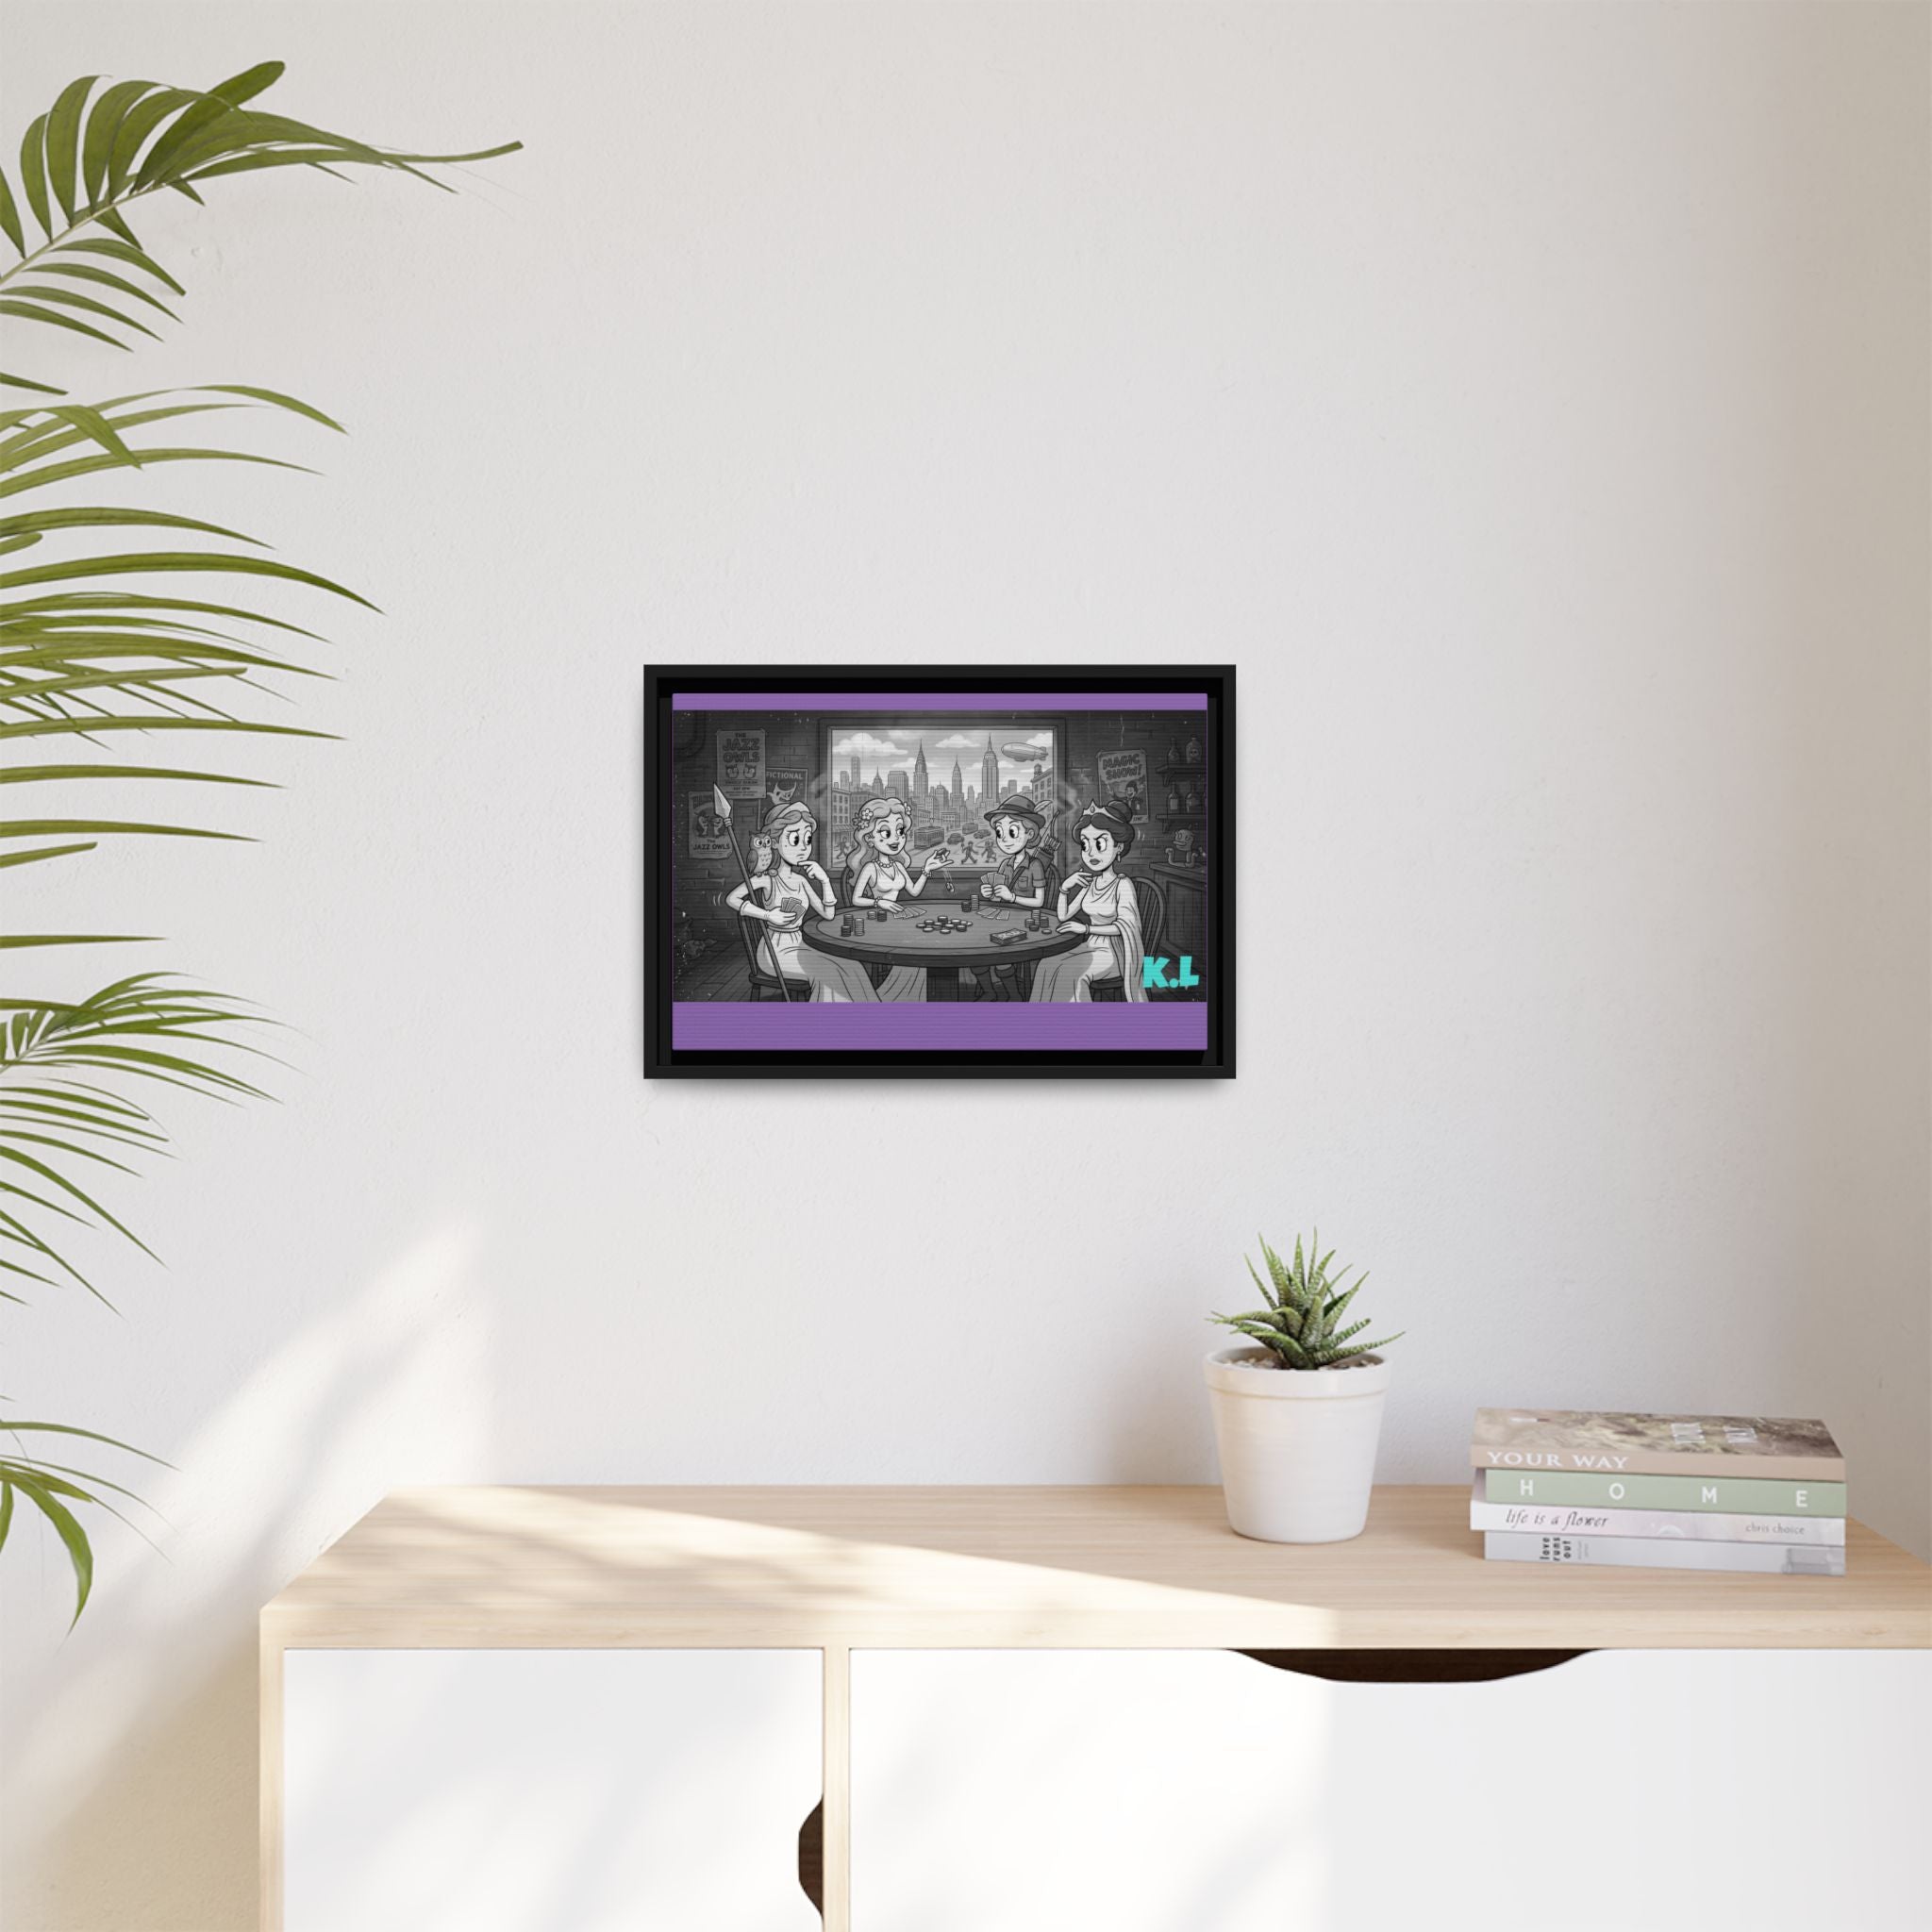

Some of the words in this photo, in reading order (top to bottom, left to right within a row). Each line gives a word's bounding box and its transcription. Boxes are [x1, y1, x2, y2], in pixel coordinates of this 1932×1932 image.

[723, 738, 760, 751] JAZZ
[723, 752, 760, 763] OWLS
[1103, 754, 1141, 771] MAGIC
[1106, 763, 1142, 781] SHOW!
[1143, 956, 1200, 989] K.L
[1487, 1451, 1564, 1467] YOUR
[1572, 1455, 1629, 1470] WAY
[1506, 1508, 1529, 1528] life
[1534, 1511, 1546, 1524] is
[1551, 1515, 1558, 1525] a
[1561, 1510, 1609, 1531] flower
[1745, 1522, 1770, 1534] chris
[1772, 1523, 1806, 1535] choice
[1540, 1537, 1550, 1560] love
[1562, 1541, 1572, 1558] out
